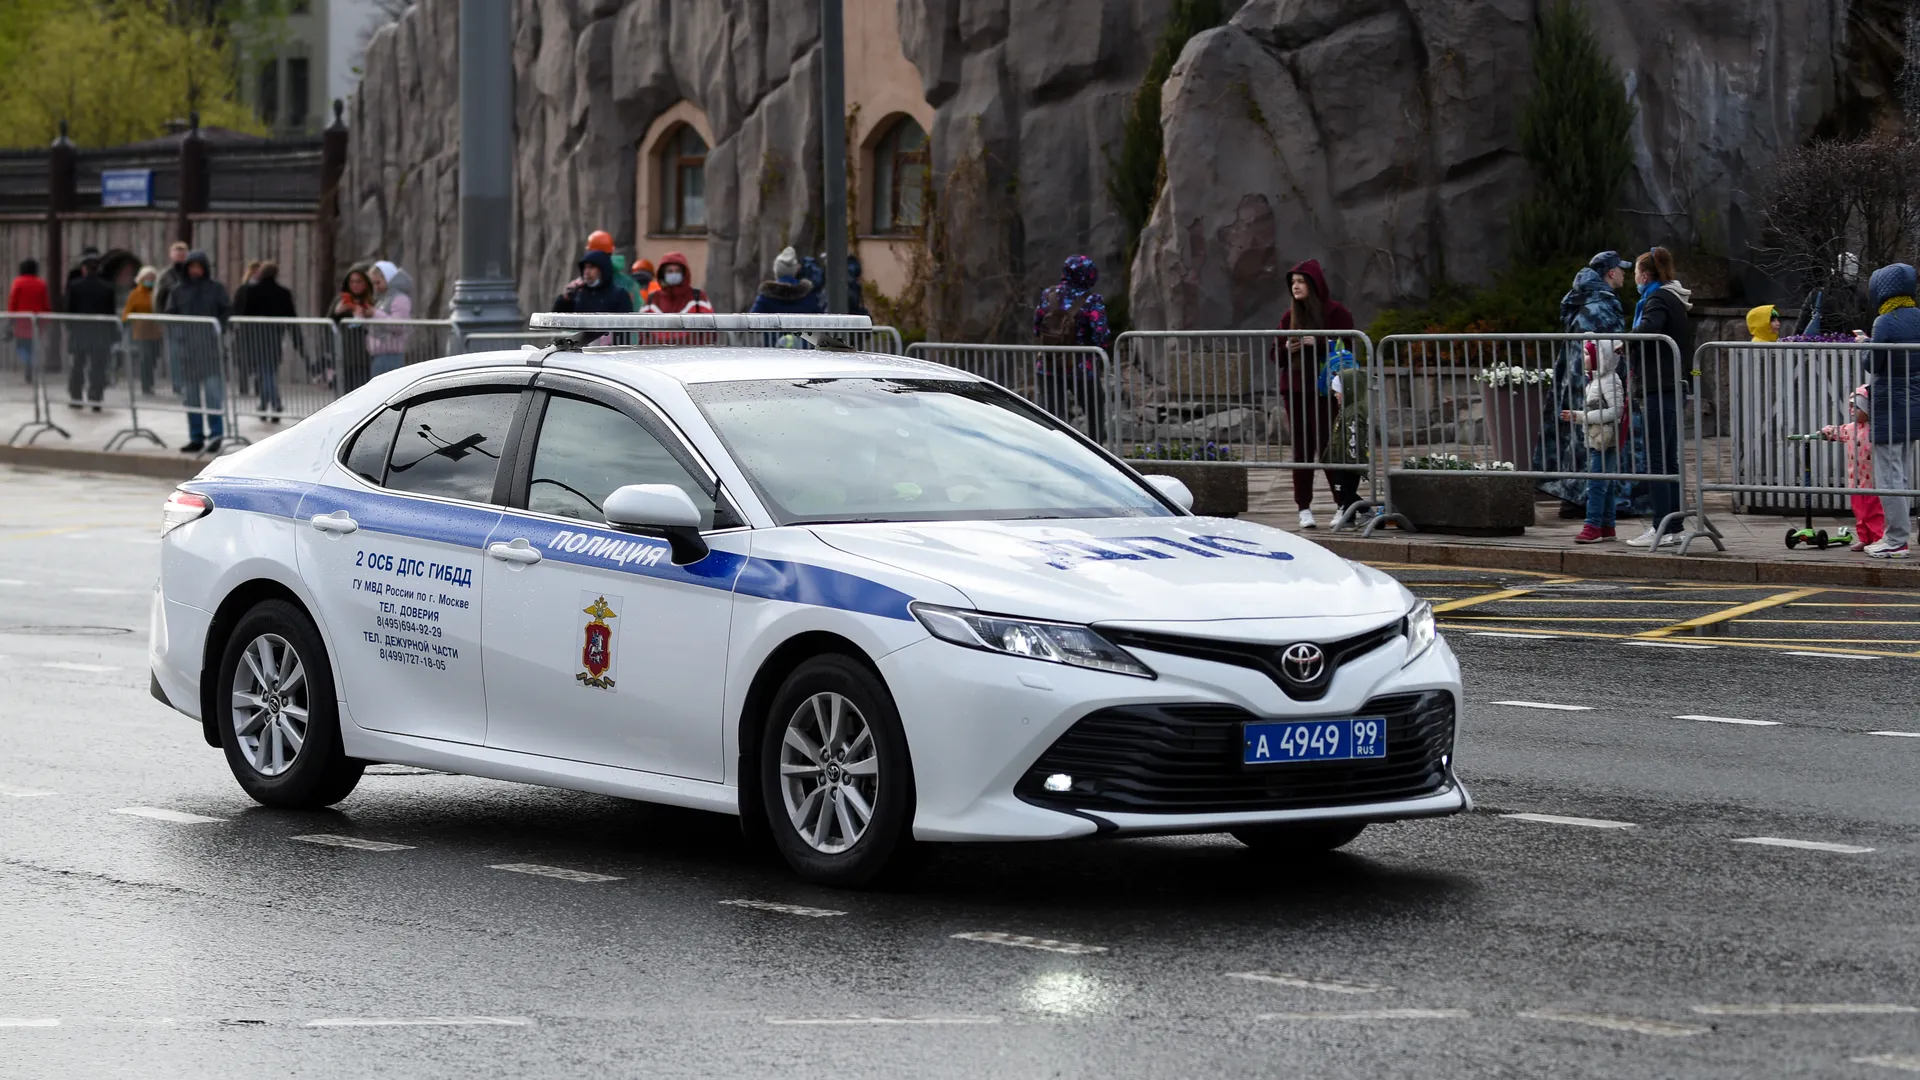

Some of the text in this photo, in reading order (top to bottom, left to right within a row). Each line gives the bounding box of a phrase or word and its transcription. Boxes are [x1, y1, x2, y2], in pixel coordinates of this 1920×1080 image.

[547, 530, 667, 567] ПОЛИЦИЯ
[355, 550, 472, 588] 2 ОСБ ДПС ГИБДД
[352, 578, 470, 610] ГУ МВД России по г. Москве
[379, 601, 439, 622] ТЕЛ. ДОВЕРИЯ
[376, 615, 442, 638] 8(495)694-92-29
[363, 631, 459, 659] ТЕЛ. ДЕЖУРНОЙ ЧАСТИ
[379, 648, 446, 671] 8(499)727-18-05
[1255, 725, 1340, 758] А 4949
[1353, 721, 1377, 745] 99
[1356, 745, 1375, 755] RUS
